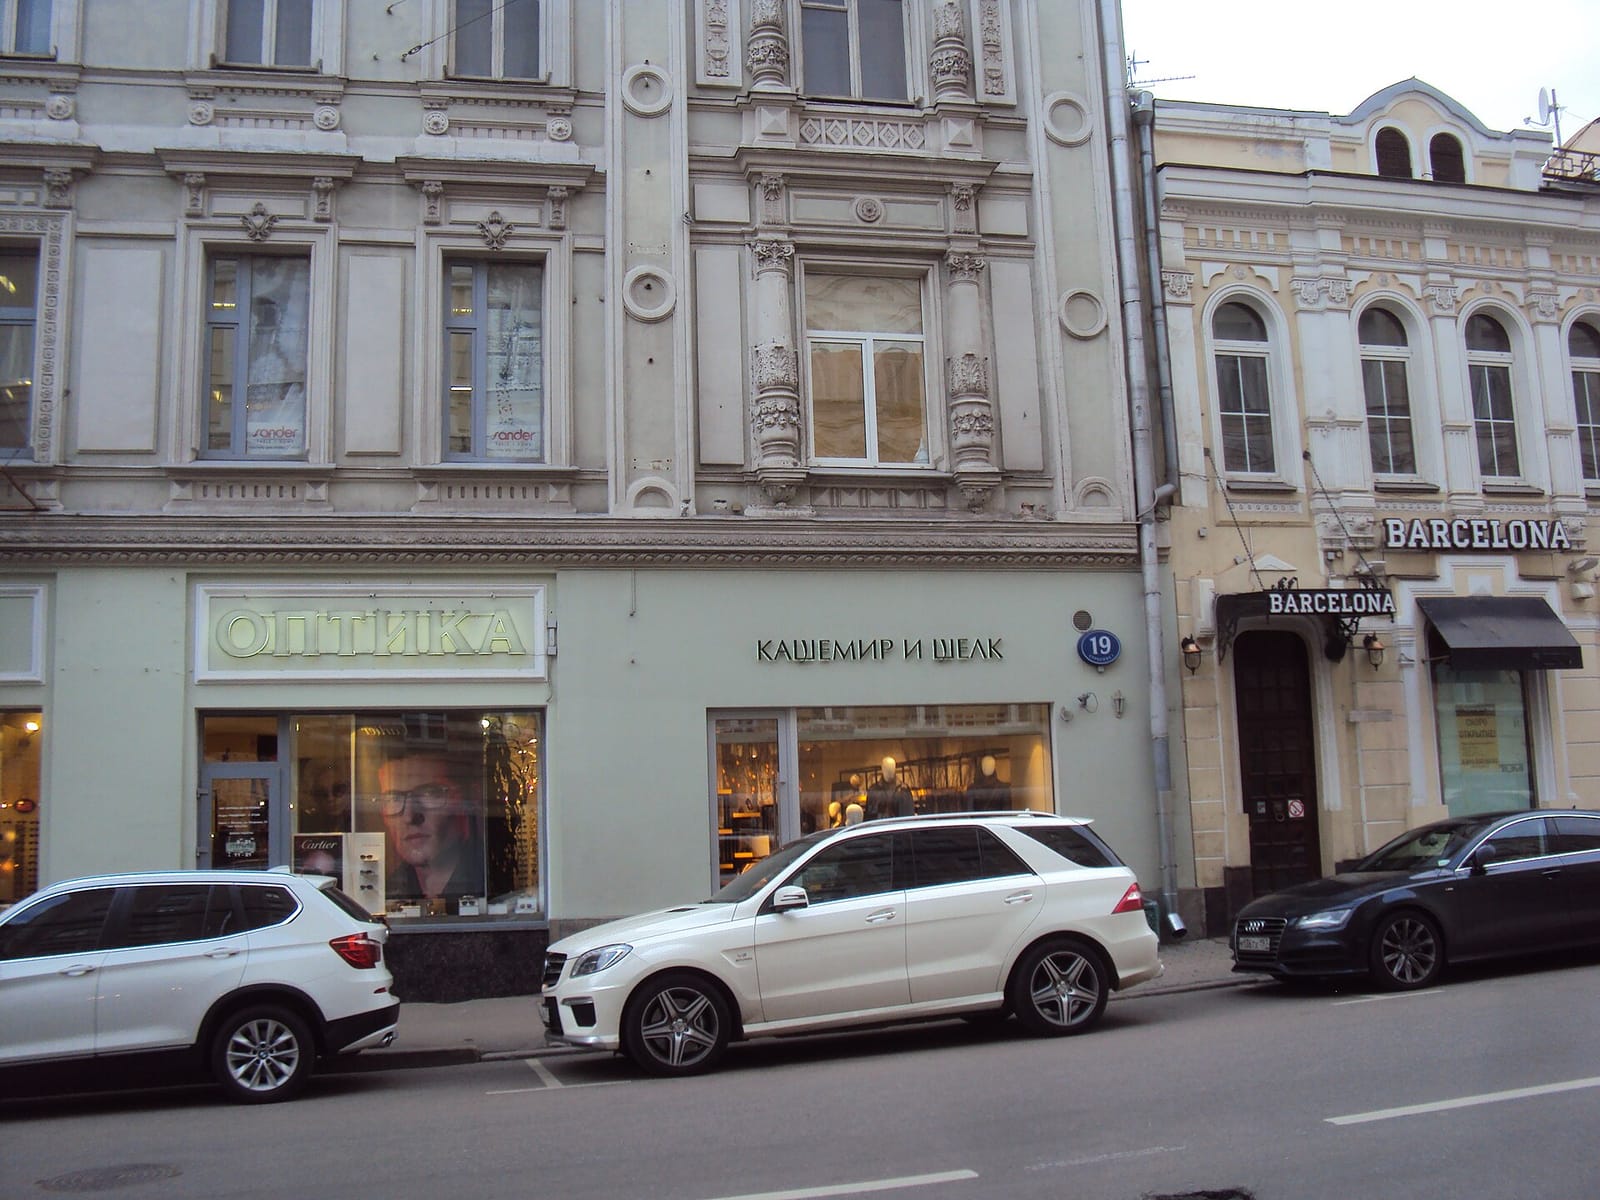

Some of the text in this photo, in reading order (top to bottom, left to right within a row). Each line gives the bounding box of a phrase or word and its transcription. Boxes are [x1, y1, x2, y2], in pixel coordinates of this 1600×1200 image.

[491, 428, 537, 441] sander
[1385, 518, 1571, 550] BARCELONA
[1269, 592, 1397, 614] BARCELONA
[215, 608, 527, 658] ОПТИКА
[756, 637, 1004, 664] КАШЕМИР И ШЕЛК
[1089, 635, 1112, 655] 19
[301, 839, 338, 850] Cartier
